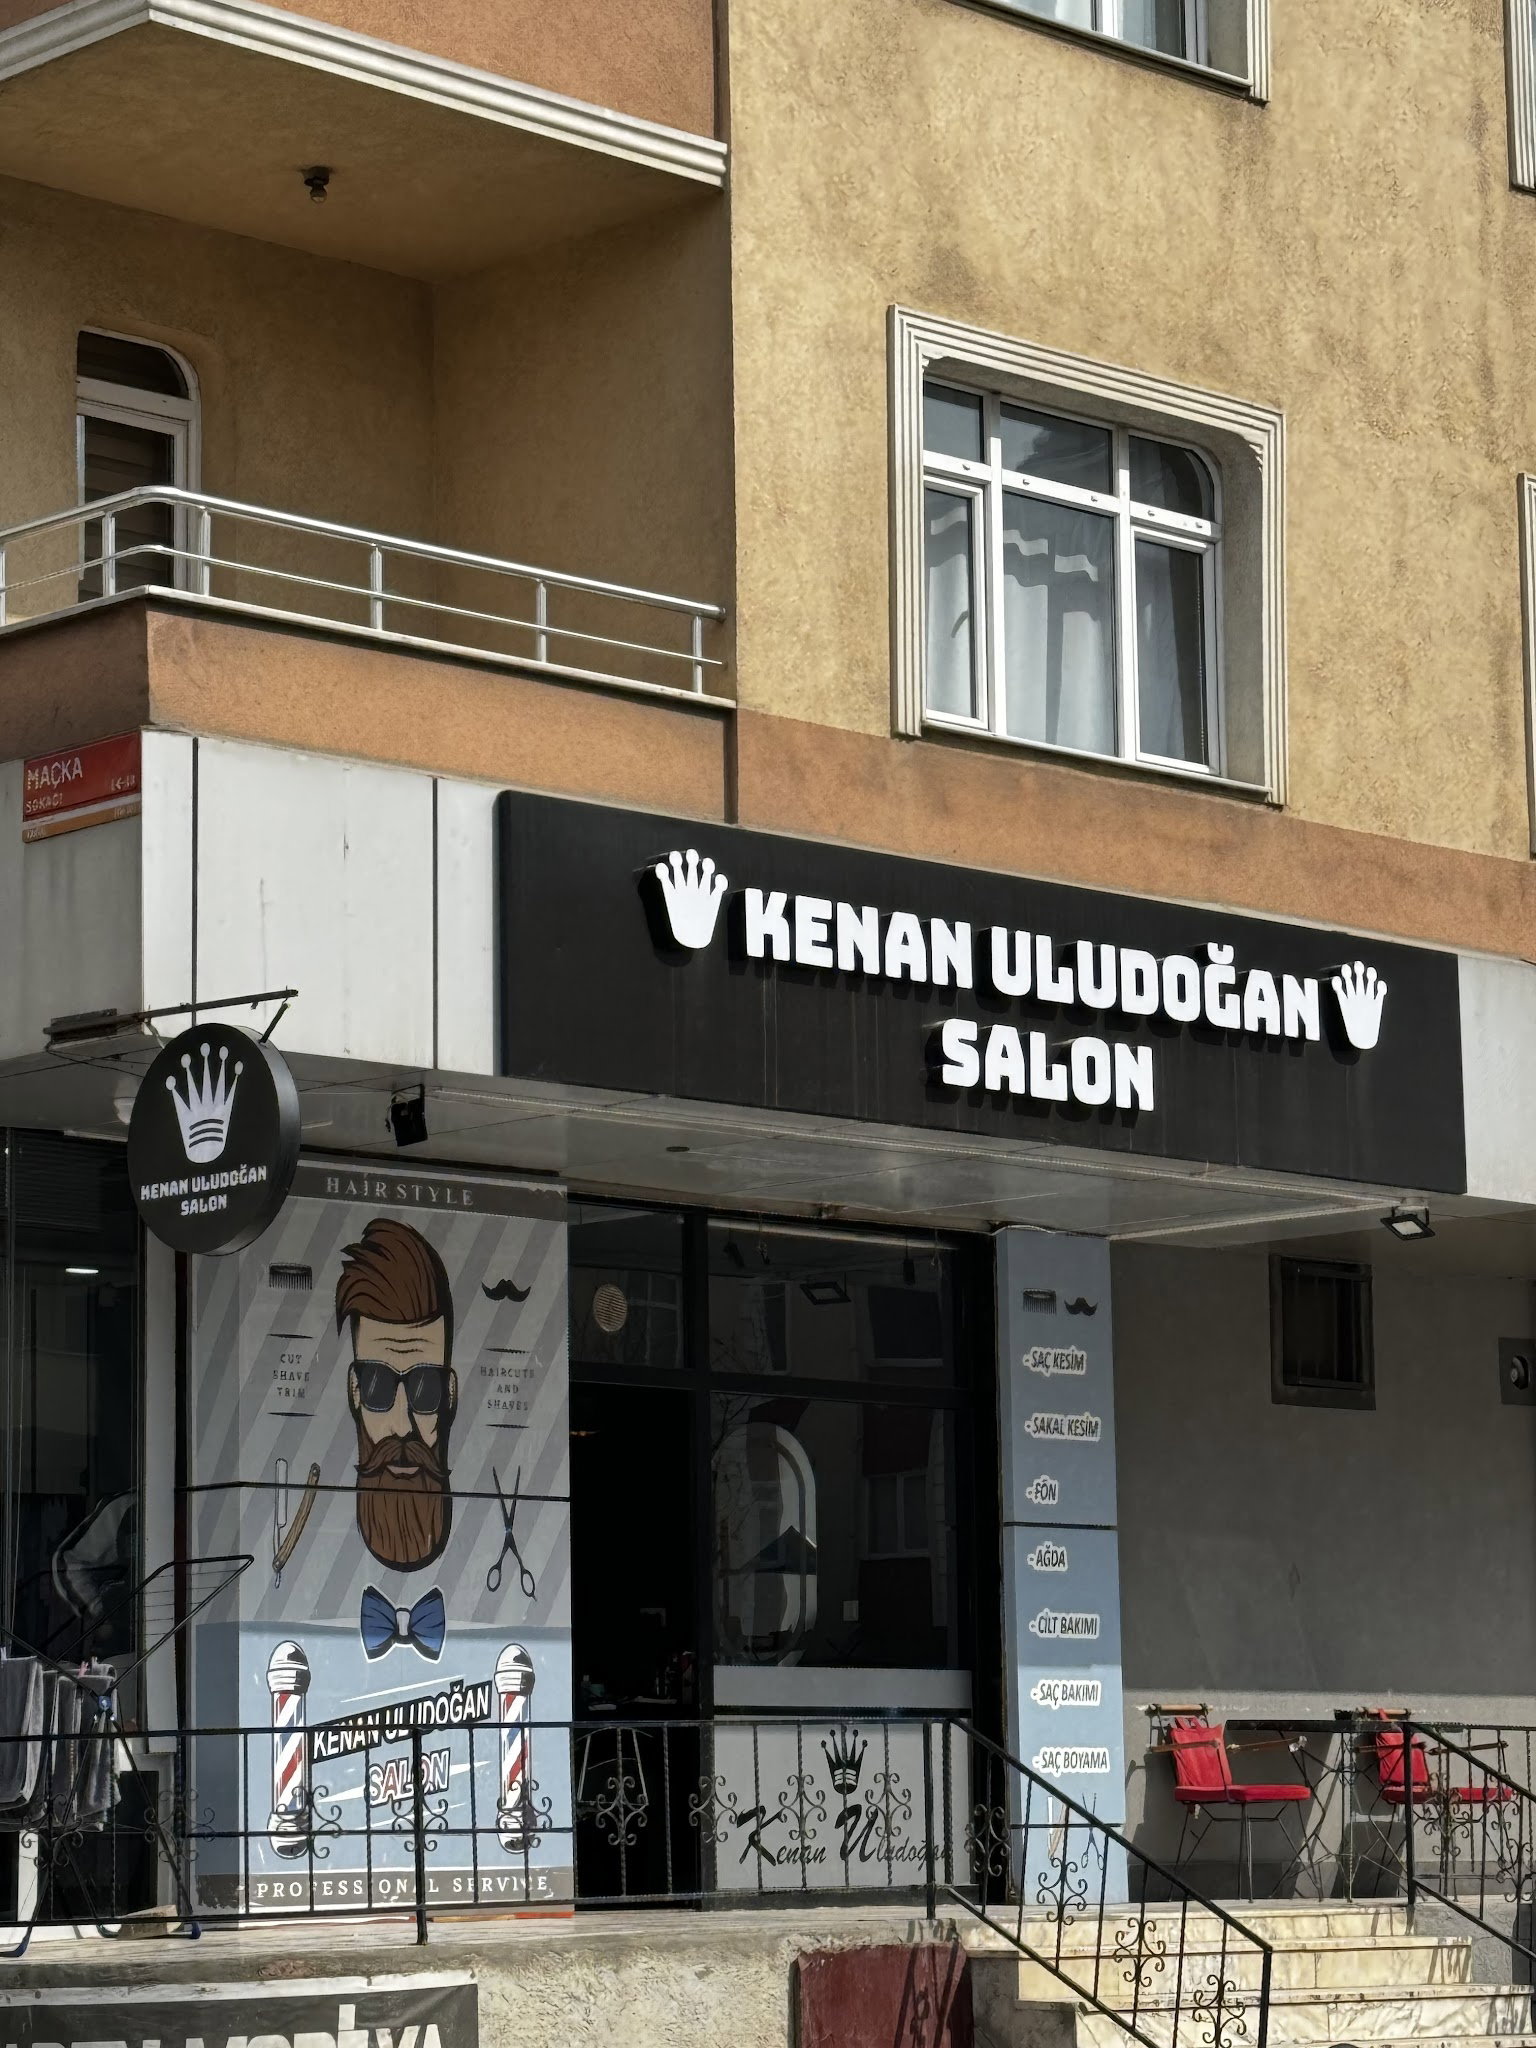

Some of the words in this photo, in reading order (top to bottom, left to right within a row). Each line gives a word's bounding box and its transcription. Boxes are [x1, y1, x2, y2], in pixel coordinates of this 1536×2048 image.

[27, 757, 83, 790] MAÇKA
[744, 887, 974, 989] KENAN
[990, 926, 1322, 1042] ULUDOĞAN
[941, 1018, 1157, 1112] SALON
[140, 1178, 189, 1201] KENAN
[191, 1163, 267, 1193] ULUDOĞAN
[180, 1193, 228, 1217] SALON
[280, 1353, 302, 1364] CUT
[1031, 1350, 1051, 1373] SAÇ
[1052, 1347, 1085, 1371] KESİM
[272, 1370, 310, 1382] SHAVE
[276, 1387, 305, 1399] TRIM
[497, 1384, 519, 1394] AND
[487, 1399, 529, 1411] SHAVES
[1032, 1416, 1066, 1436] SAKAL
[1067, 1413, 1099, 1437] KESİM
[1035, 1479, 1057, 1501] FÖN
[1036, 1545, 1066, 1568] AĞDA
[1038, 1611, 1059, 1634] CİLT
[1060, 1616, 1098, 1636] BAKIMI
[1039, 1684, 1060, 1706] SAÇ
[1062, 1684, 1099, 1702] BAKIMI
[313, 1712, 380, 1760] KENAN
[1042, 1751, 1062, 1774] SAÇ
[1063, 1751, 1108, 1769] BOYAMA
[736, 1805, 828, 1867] Kenan
[256, 1878, 439, 1898] PROESSONL
